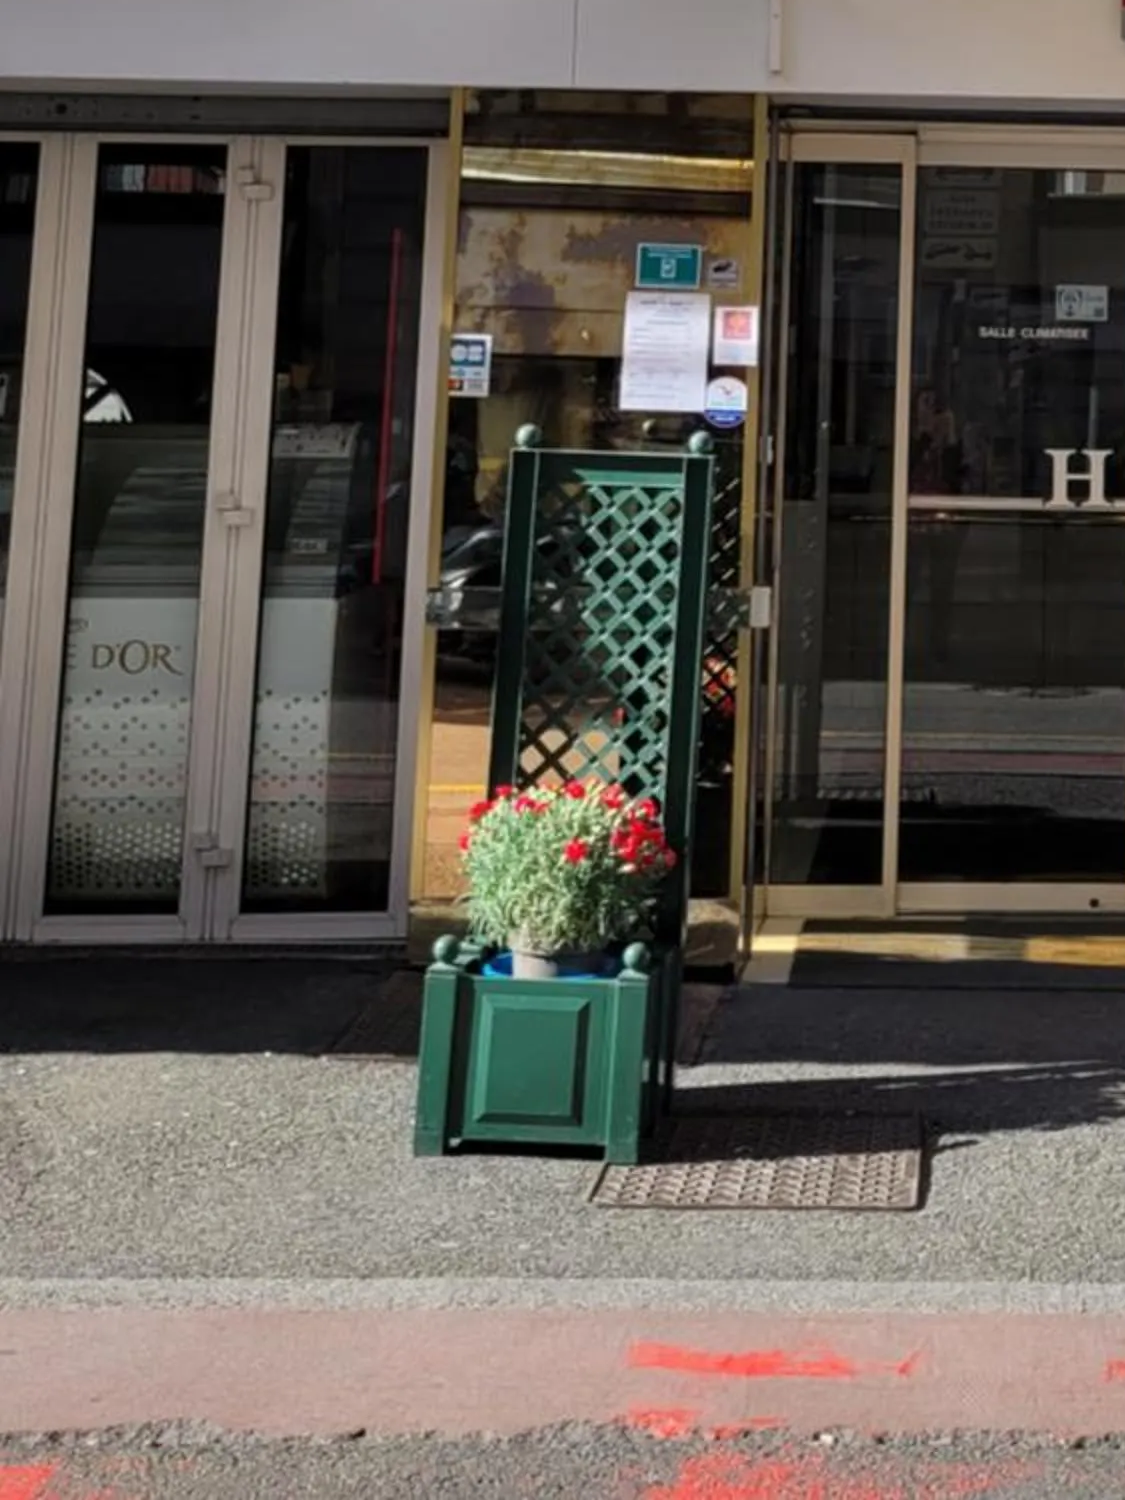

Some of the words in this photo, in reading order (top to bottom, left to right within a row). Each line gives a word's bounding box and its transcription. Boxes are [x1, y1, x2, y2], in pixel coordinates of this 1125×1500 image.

[979, 326, 1016, 339] SALLE
[1044, 449, 1115, 510] H
[91, 639, 184, 677] D'OR
